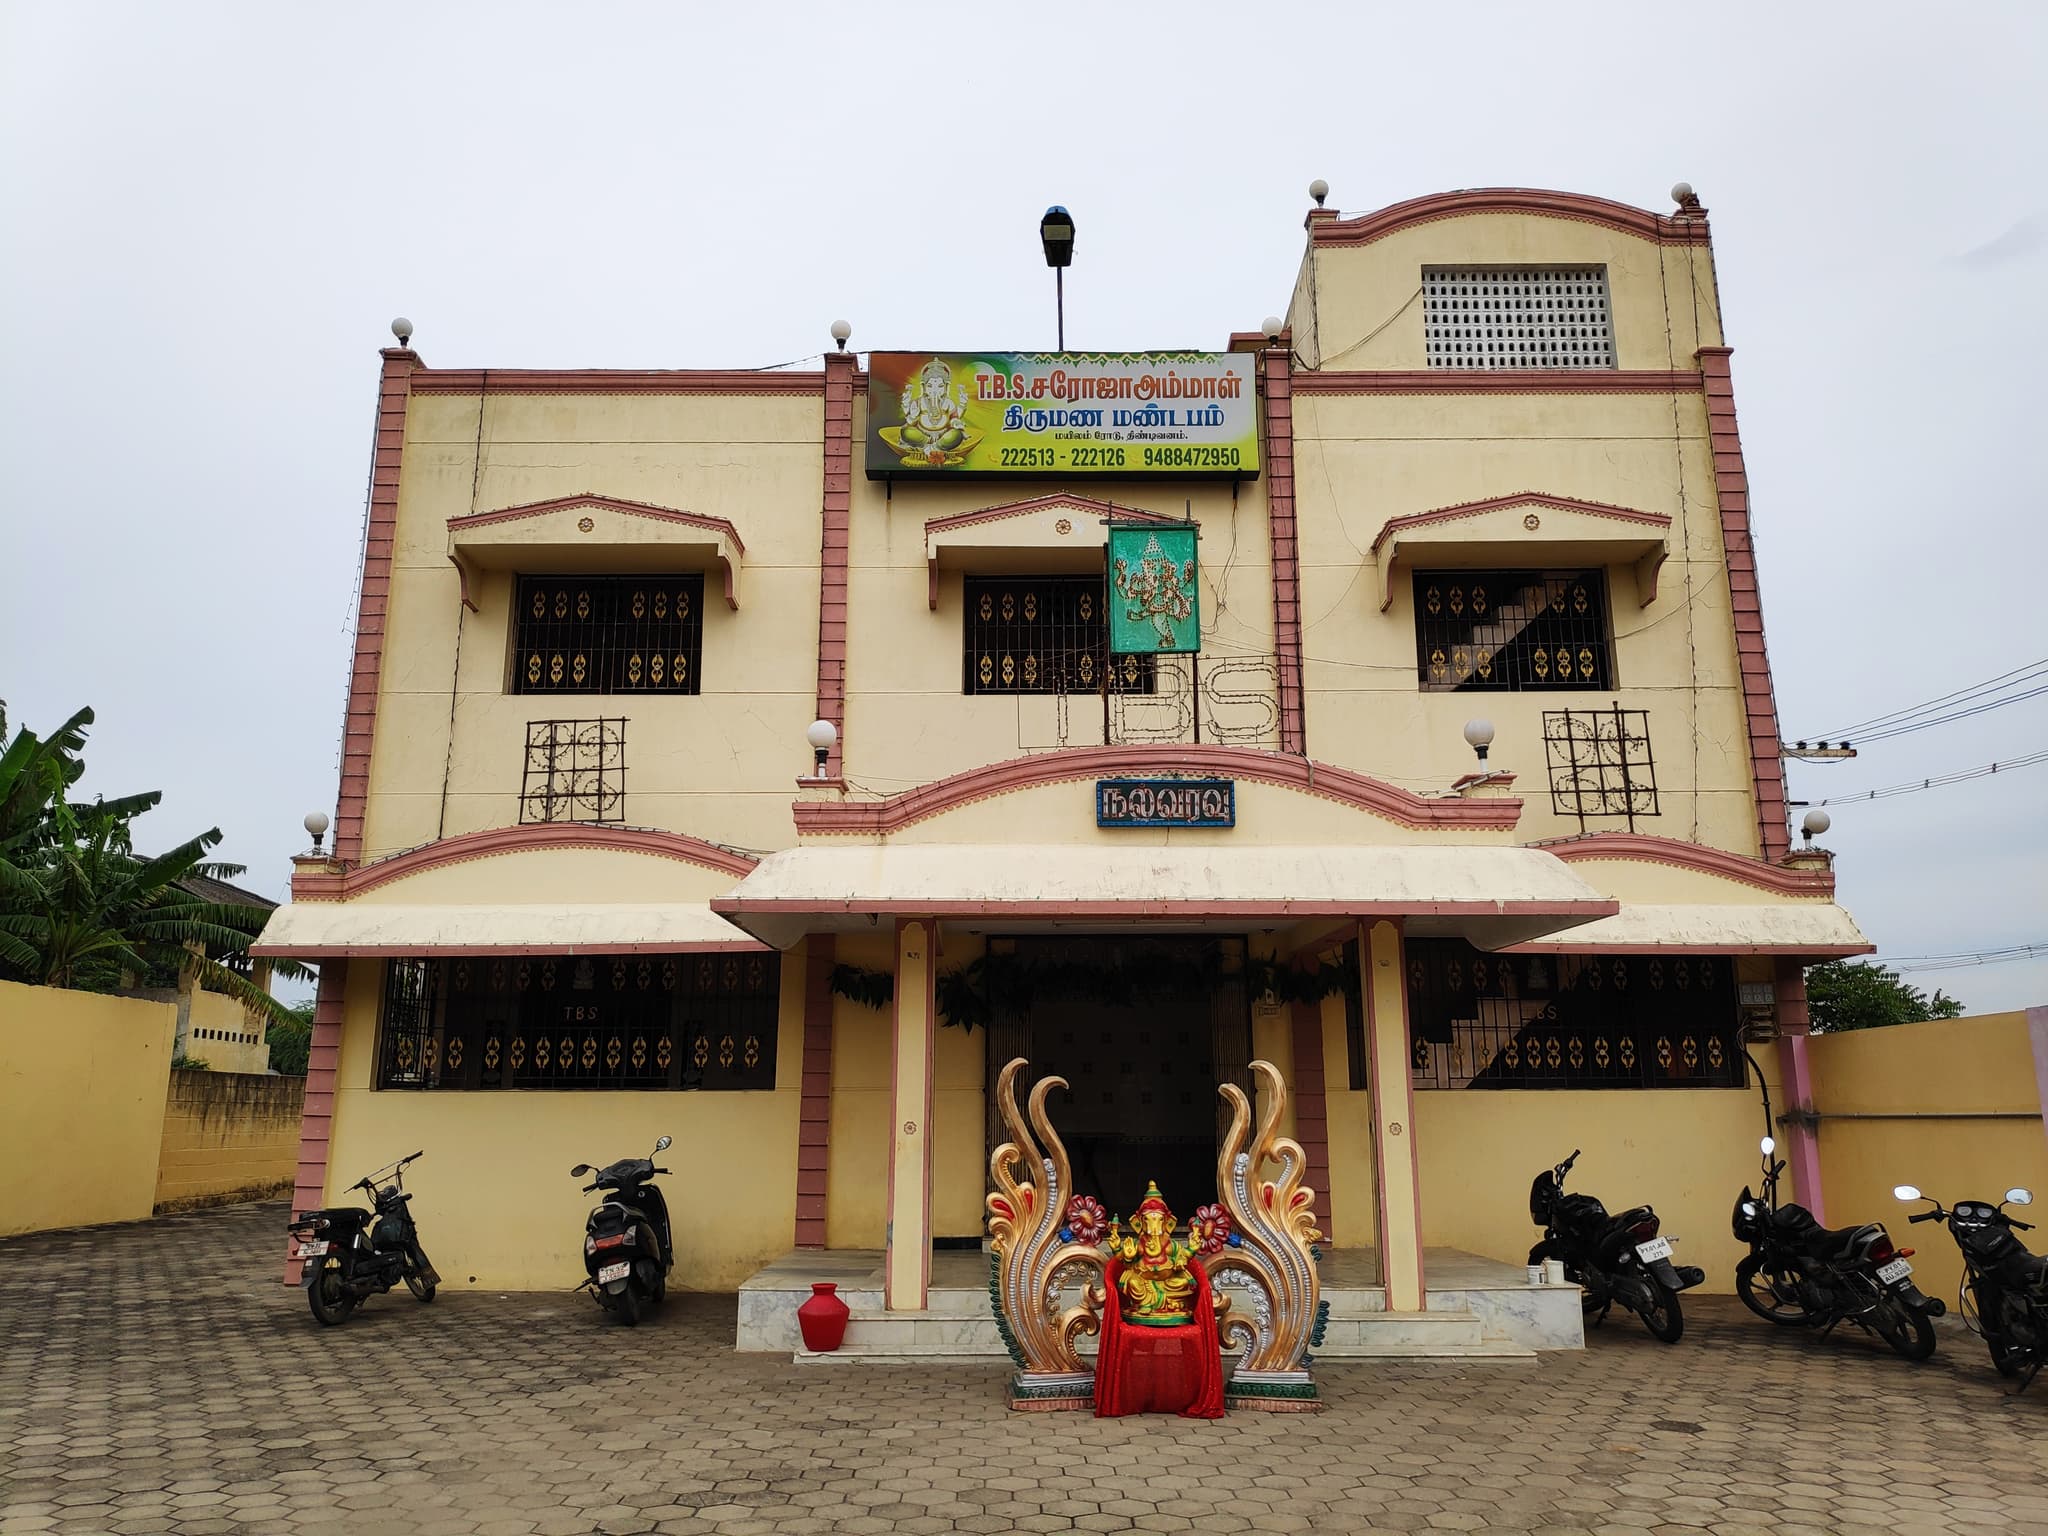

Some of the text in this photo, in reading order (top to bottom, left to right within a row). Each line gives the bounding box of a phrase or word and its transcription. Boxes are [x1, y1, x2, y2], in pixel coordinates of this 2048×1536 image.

[1003, 403, 1225, 431] திருமண மண்டபம்
[1055, 430, 1092, 440] மயிலம்
[1001, 448, 1055, 467] 222513
[1071, 448, 1125, 467] 222126
[1144, 447, 1240, 466] 9488472950
[1102, 783, 1230, 823] நல்வரவு
[562, 1006, 598, 1021] TBS
